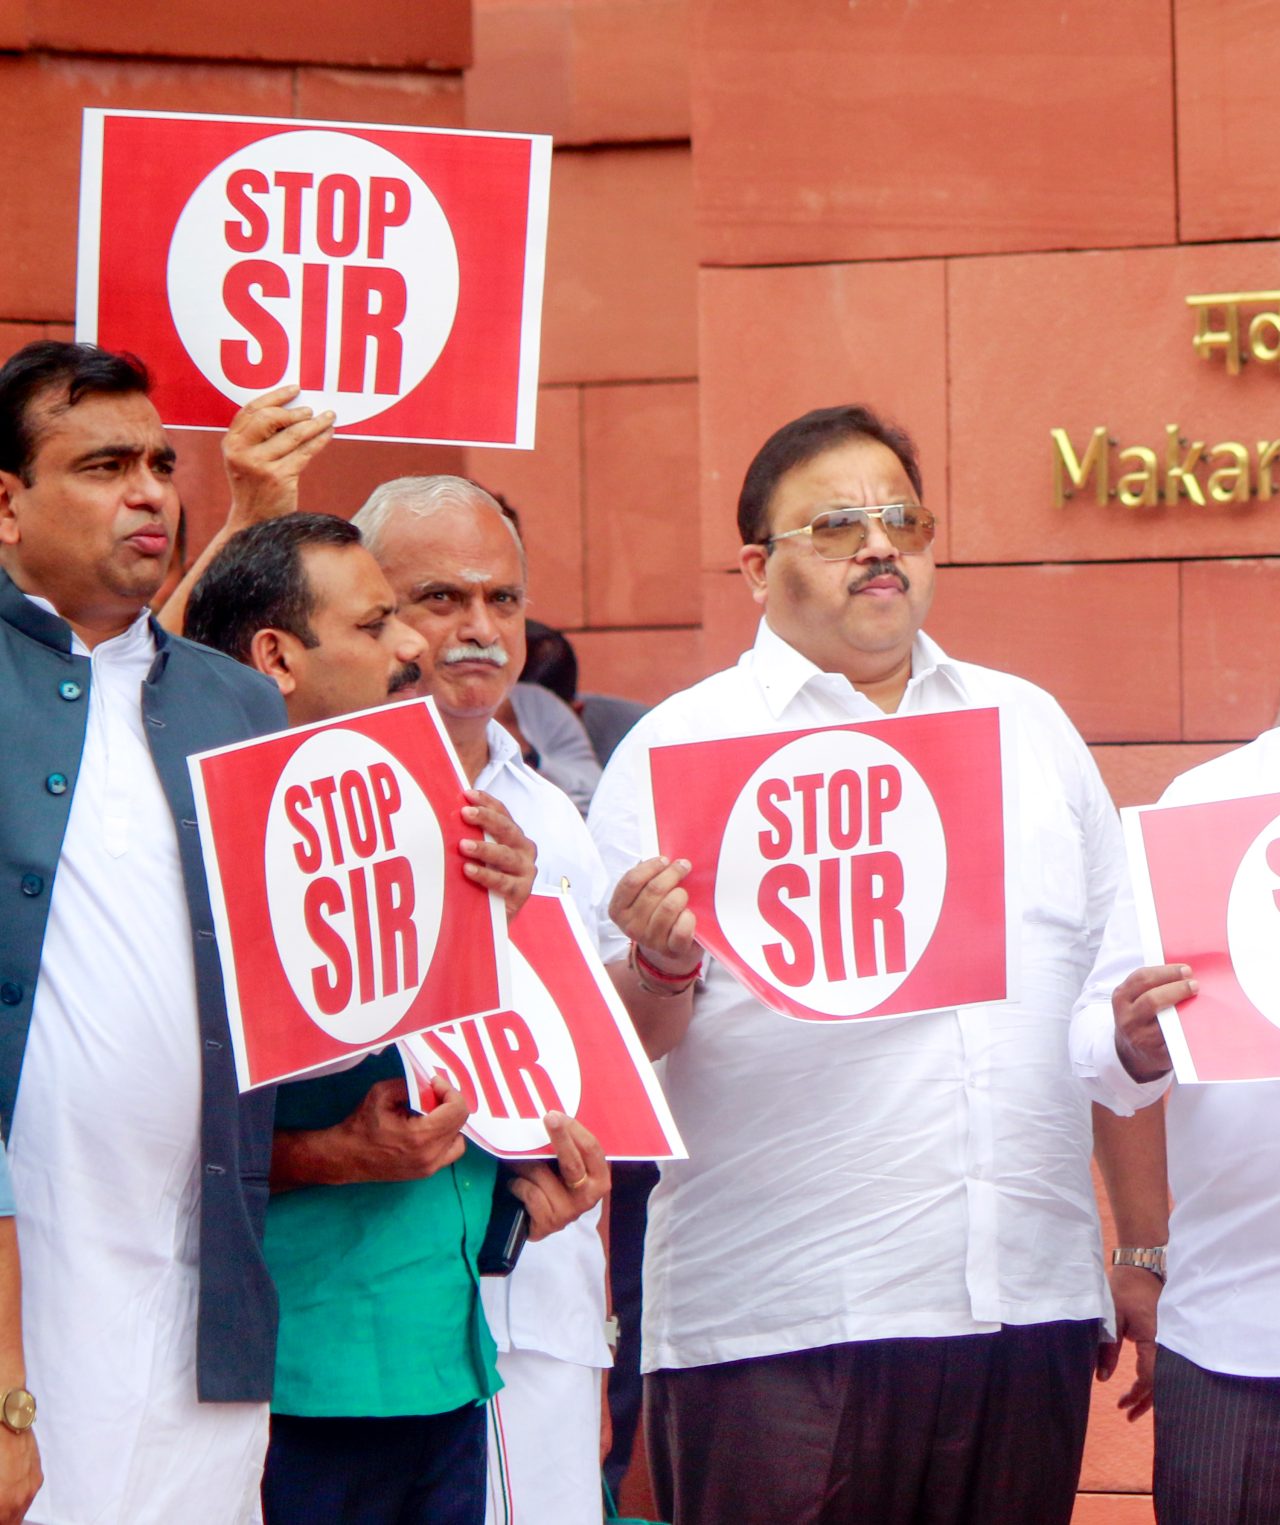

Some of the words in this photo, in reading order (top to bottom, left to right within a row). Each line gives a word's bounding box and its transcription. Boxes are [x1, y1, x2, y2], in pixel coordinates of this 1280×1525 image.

[225, 168, 412, 259] STOP
[219, 260, 408, 396] SIR
[284, 762, 402, 874] STOP
[756, 764, 902, 860] STOP
[304, 855, 420, 1016] SIR
[757, 850, 907, 988] SIR
